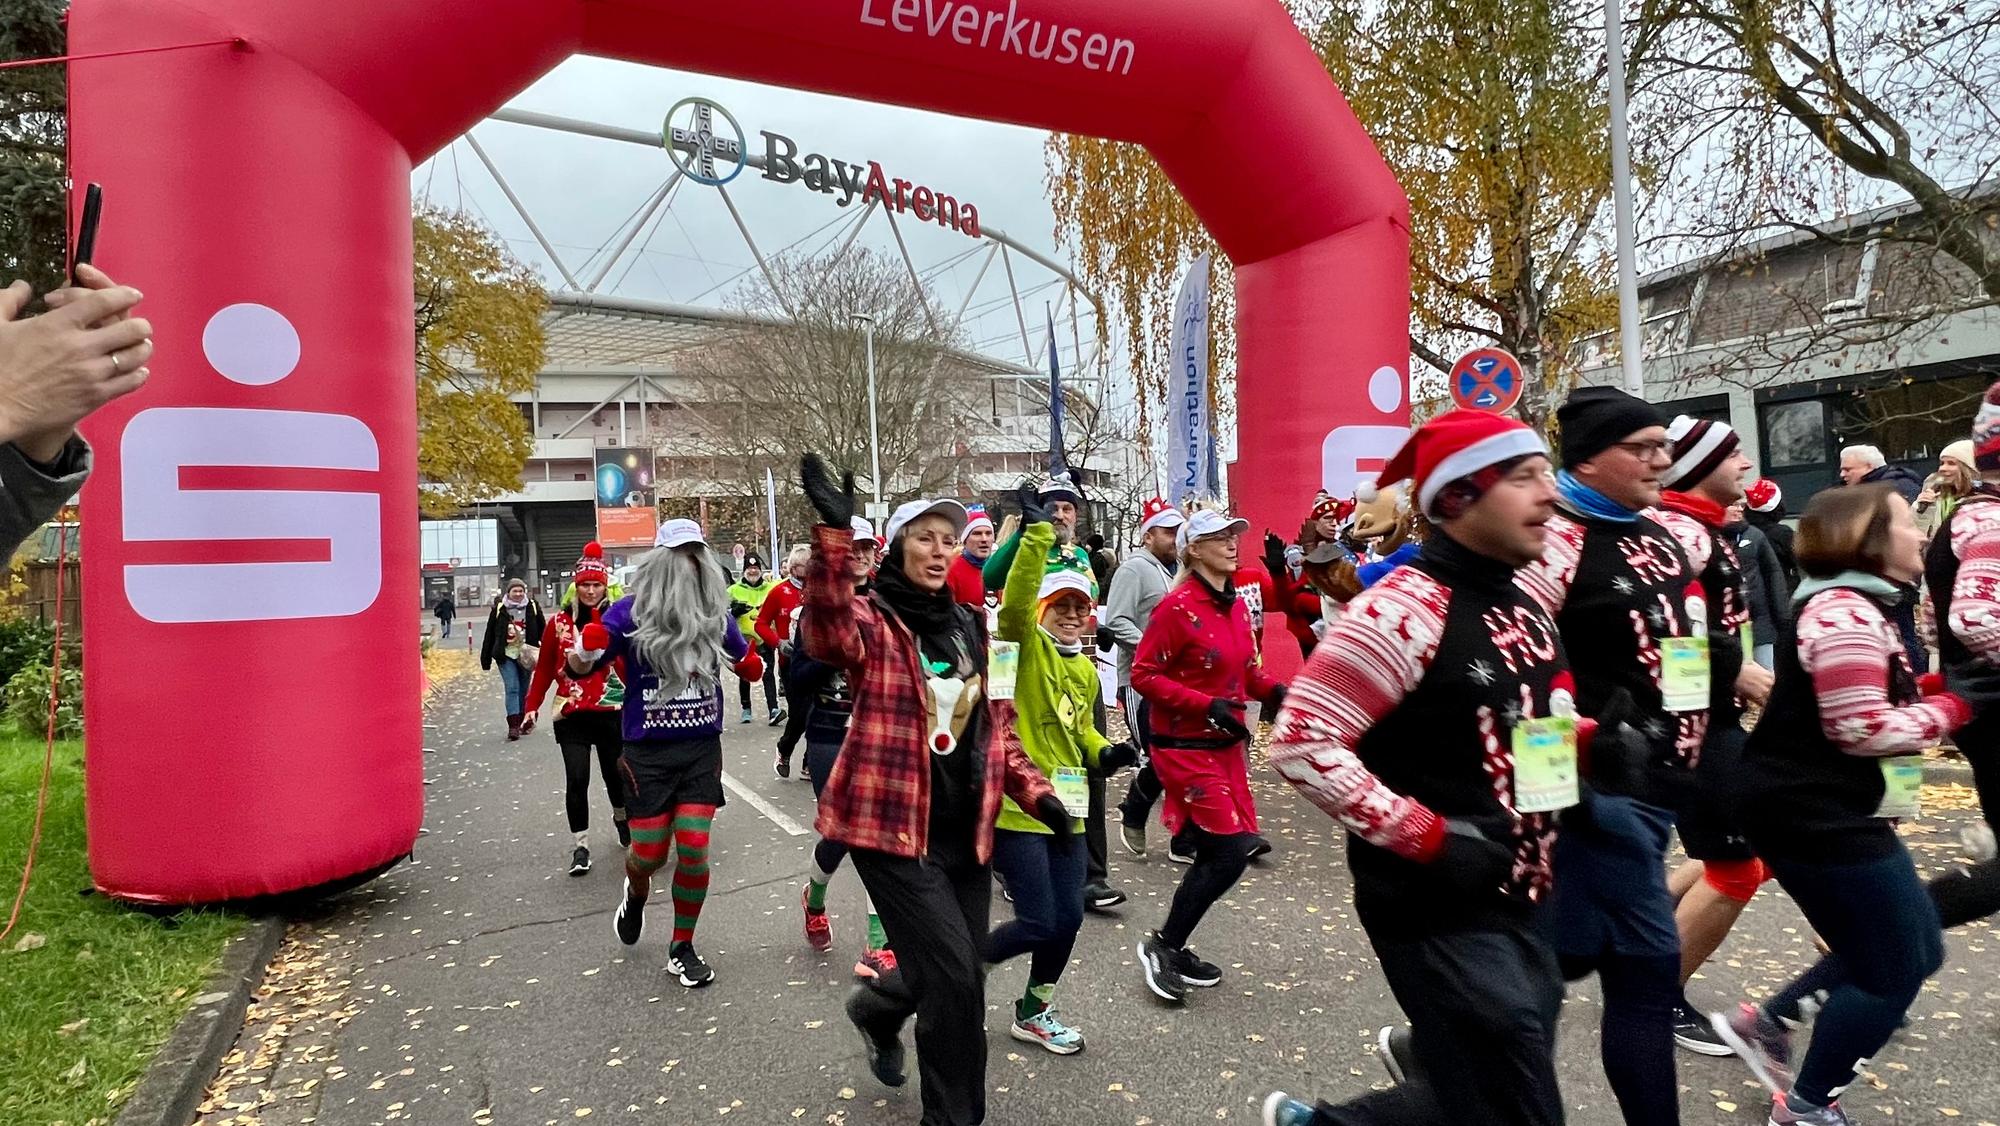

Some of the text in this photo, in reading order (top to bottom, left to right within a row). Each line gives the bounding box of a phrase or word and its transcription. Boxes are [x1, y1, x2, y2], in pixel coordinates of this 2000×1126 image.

[859, 0, 1136, 75] Leverkusen
[672, 127, 740, 154] BAYER
[698, 103, 714, 178] BAYER
[759, 130, 982, 238] BayArena
[1185, 346, 1200, 487] Marathon
[1482, 606, 1556, 674] HO
